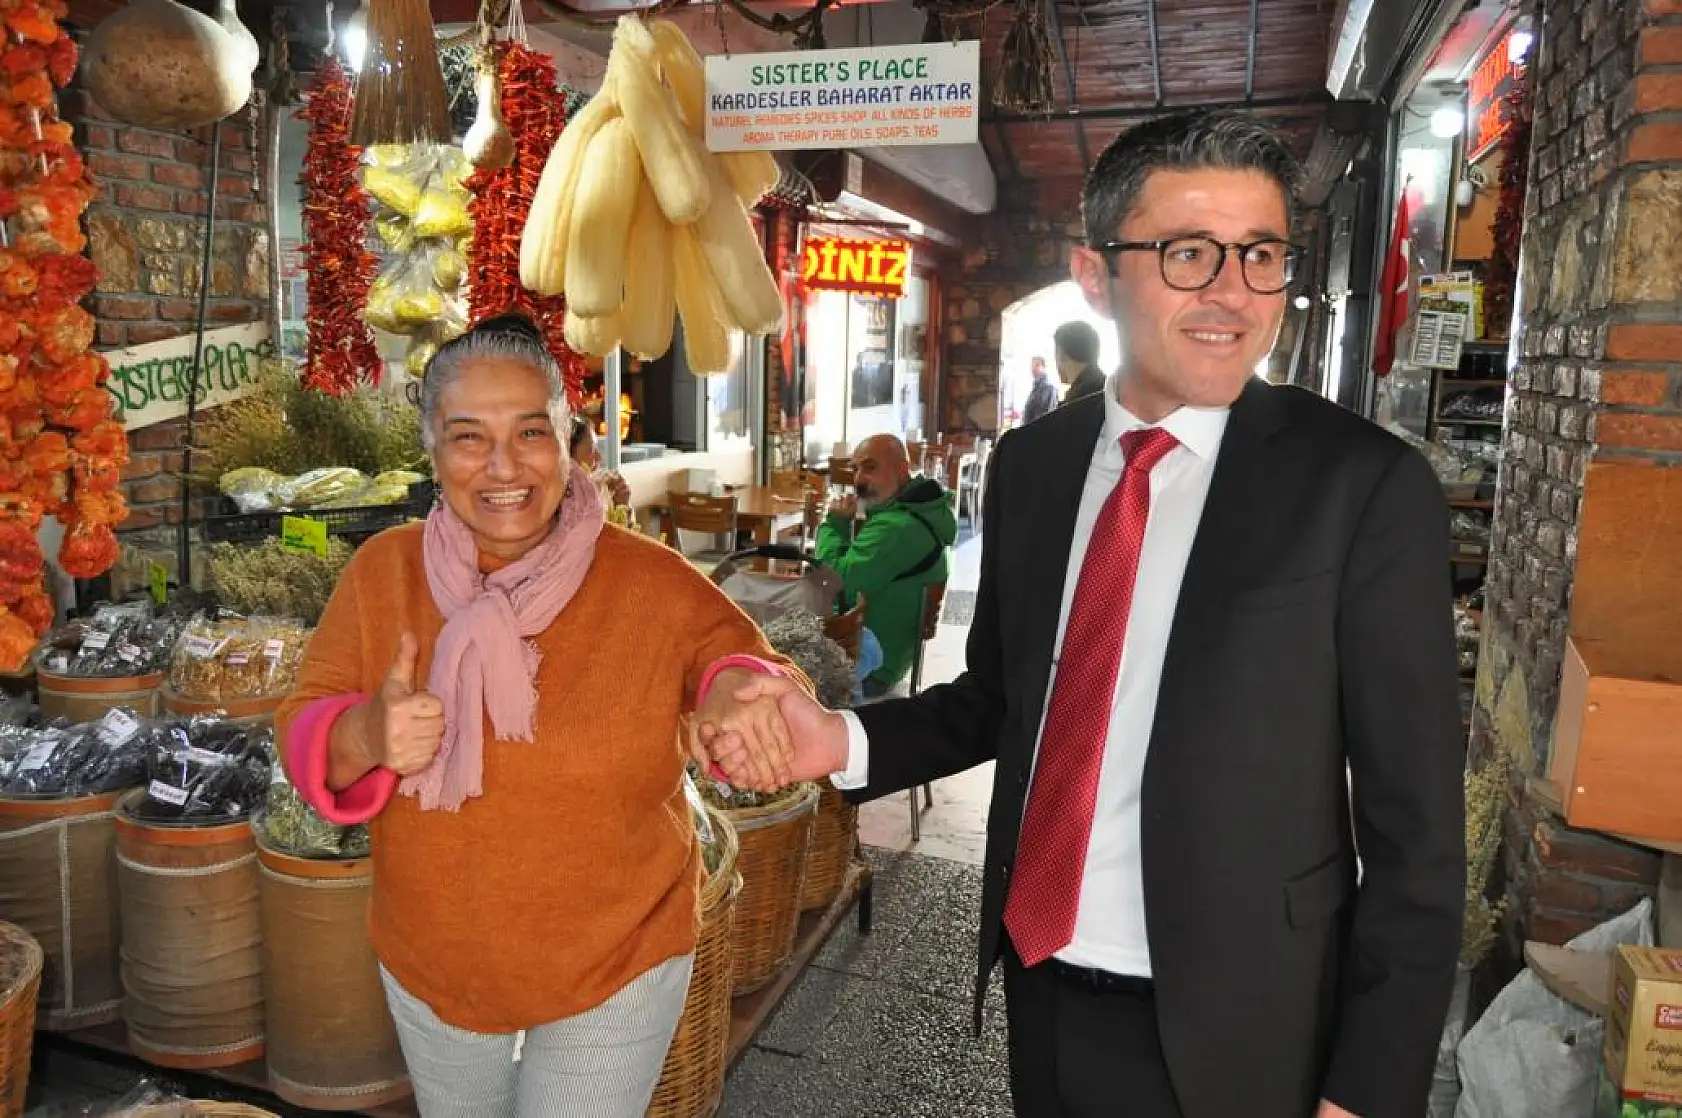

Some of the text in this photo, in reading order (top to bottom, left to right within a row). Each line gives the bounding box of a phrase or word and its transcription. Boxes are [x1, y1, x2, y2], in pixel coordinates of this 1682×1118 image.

[750, 57, 928, 86] SISTER'S PLACE
[711, 82, 971, 112] KARDEŞLER BAHARAT AKTAR
[841, 109, 867, 123] SHOP
[872, 108, 887, 120] ALL
[890, 106, 920, 120] KINDS
[924, 106, 937, 119] OF
[939, 104, 972, 119] HERBS
[743, 131, 775, 144] AROMA
[778, 129, 819, 142] THERAPY
[822, 128, 849, 141] PURE
